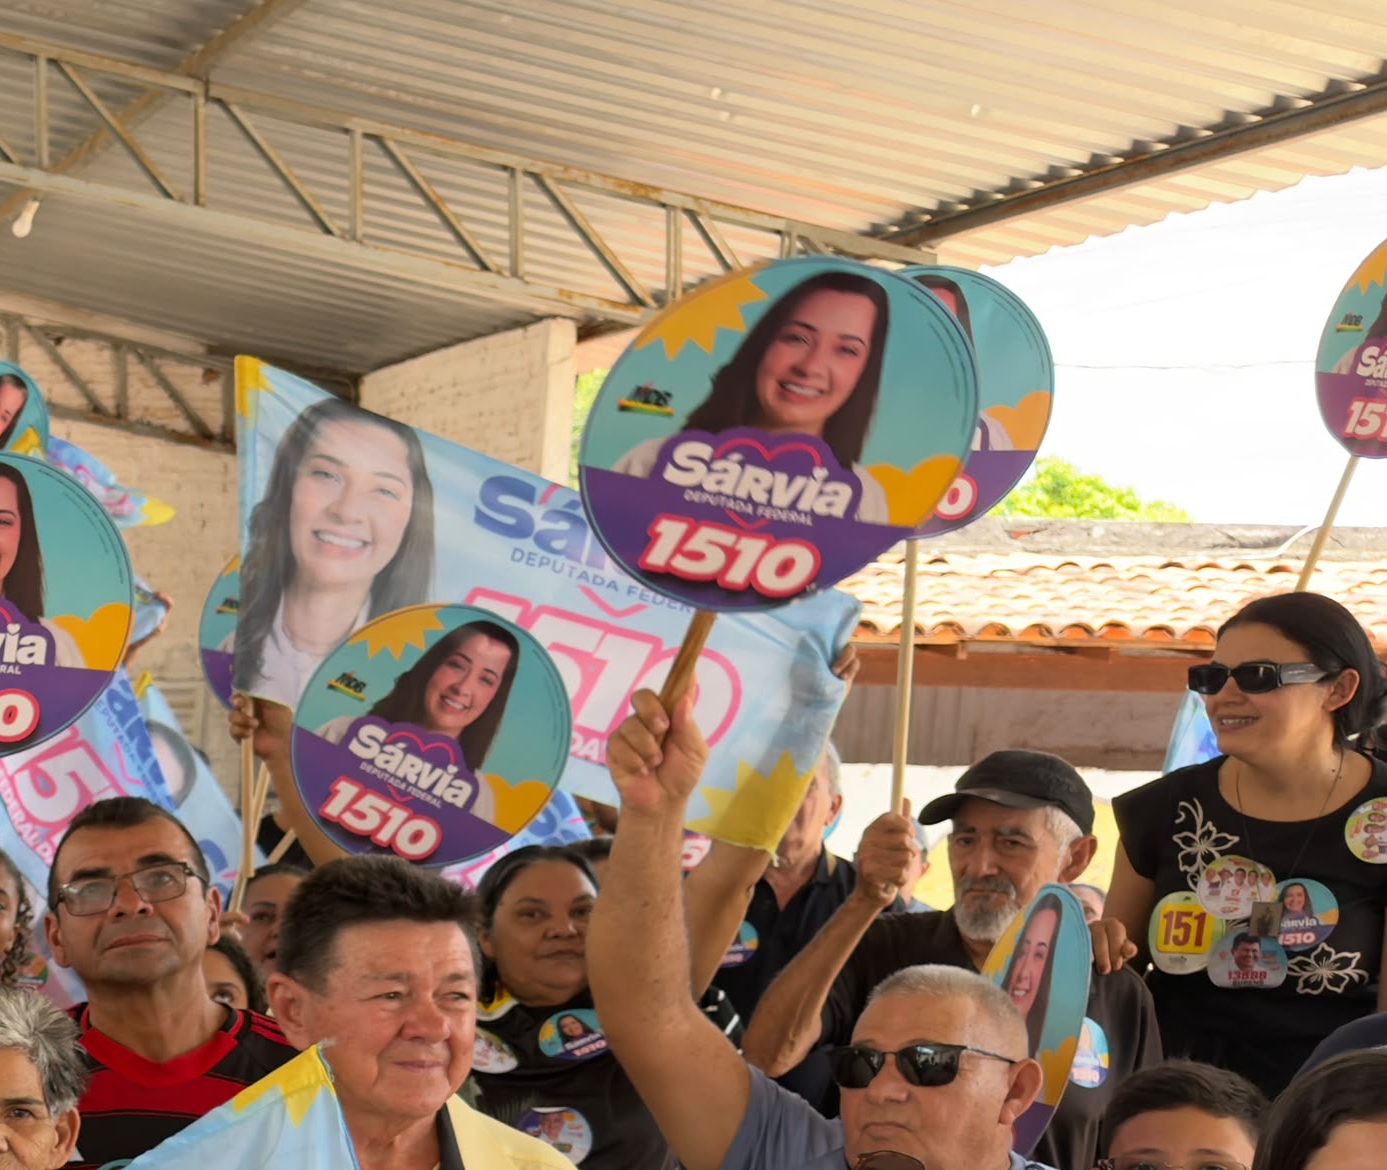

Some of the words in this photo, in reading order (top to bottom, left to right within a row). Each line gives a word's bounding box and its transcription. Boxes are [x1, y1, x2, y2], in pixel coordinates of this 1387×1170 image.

[662, 441, 853, 518] Sárvia
[684, 489, 755, 515] DEPUTADA
[757, 504, 814, 526] FEDERAL
[509, 546, 621, 594] DEPUTADA
[625, 581, 697, 615] FEDER
[643, 517, 816, 594] 1510
[348, 724, 473, 808] Sárvia
[360, 762, 406, 792] DEPUTADA
[407, 785, 441, 808] FEDERAL
[323, 781, 438, 857] 1510
[1163, 910, 1207, 947] 151
